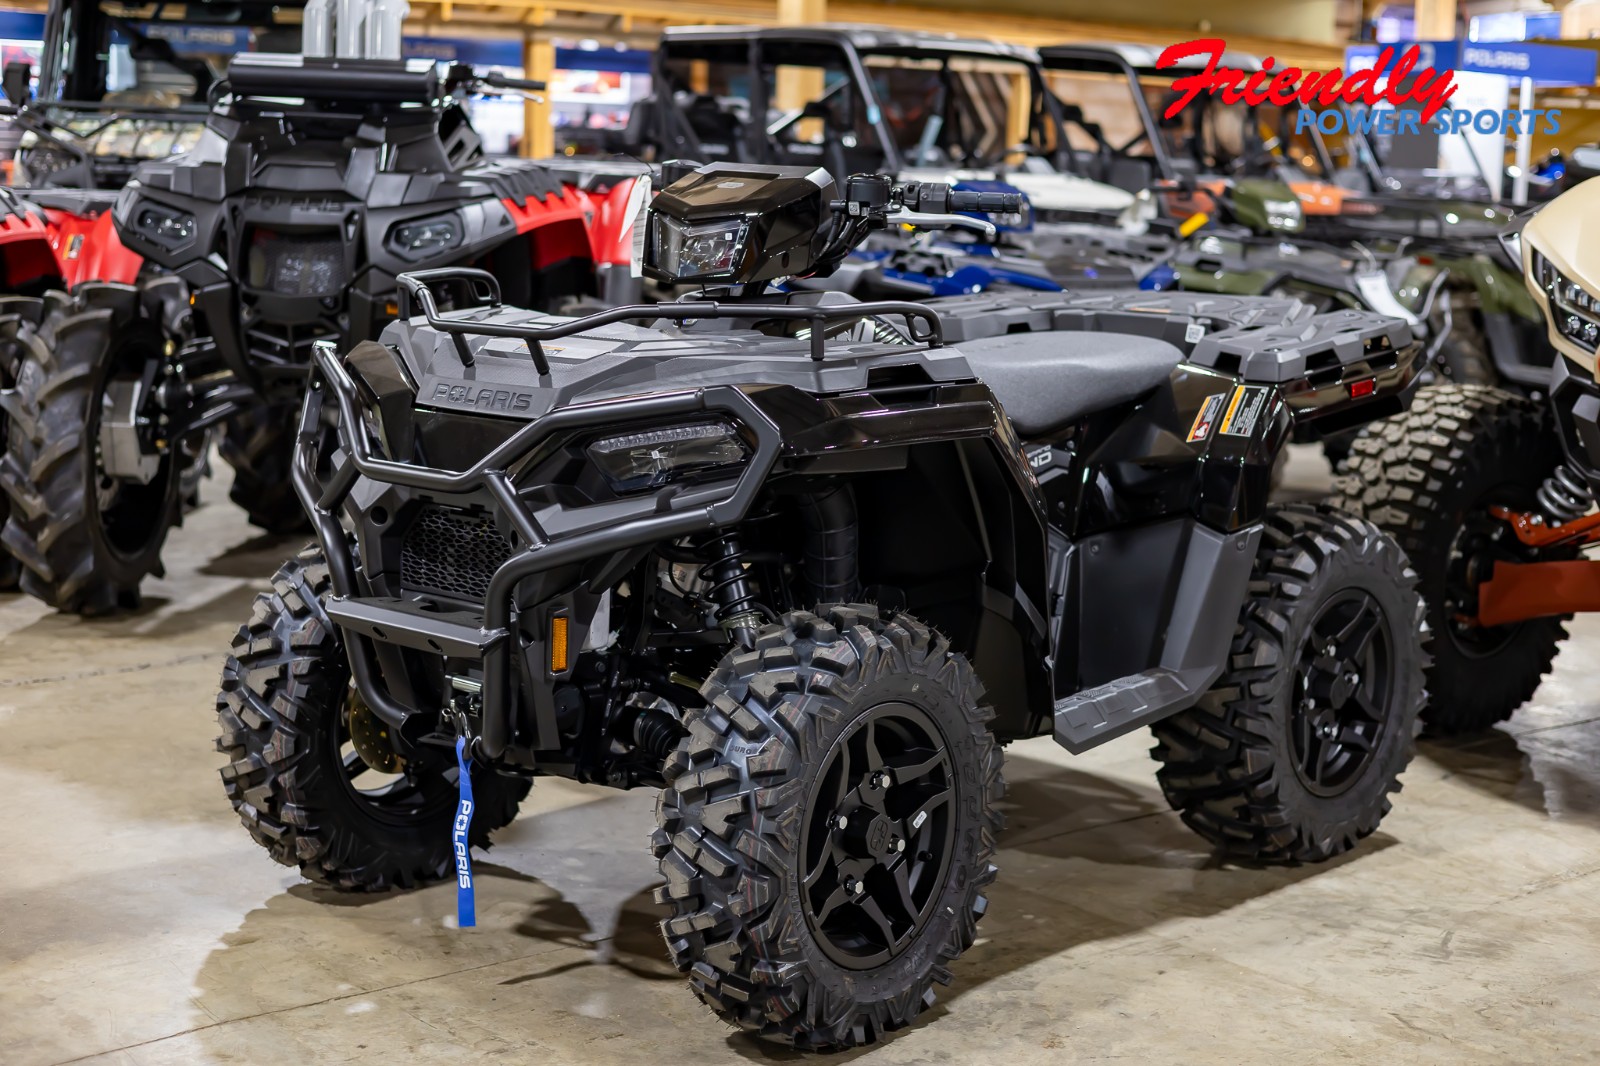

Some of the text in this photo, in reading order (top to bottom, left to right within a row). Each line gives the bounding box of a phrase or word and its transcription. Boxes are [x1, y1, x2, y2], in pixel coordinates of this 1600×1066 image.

[1463, 48, 1530, 70] POLARIS
[432, 383, 533, 411] POLARIS
[454, 799, 473, 889] POLARIS
